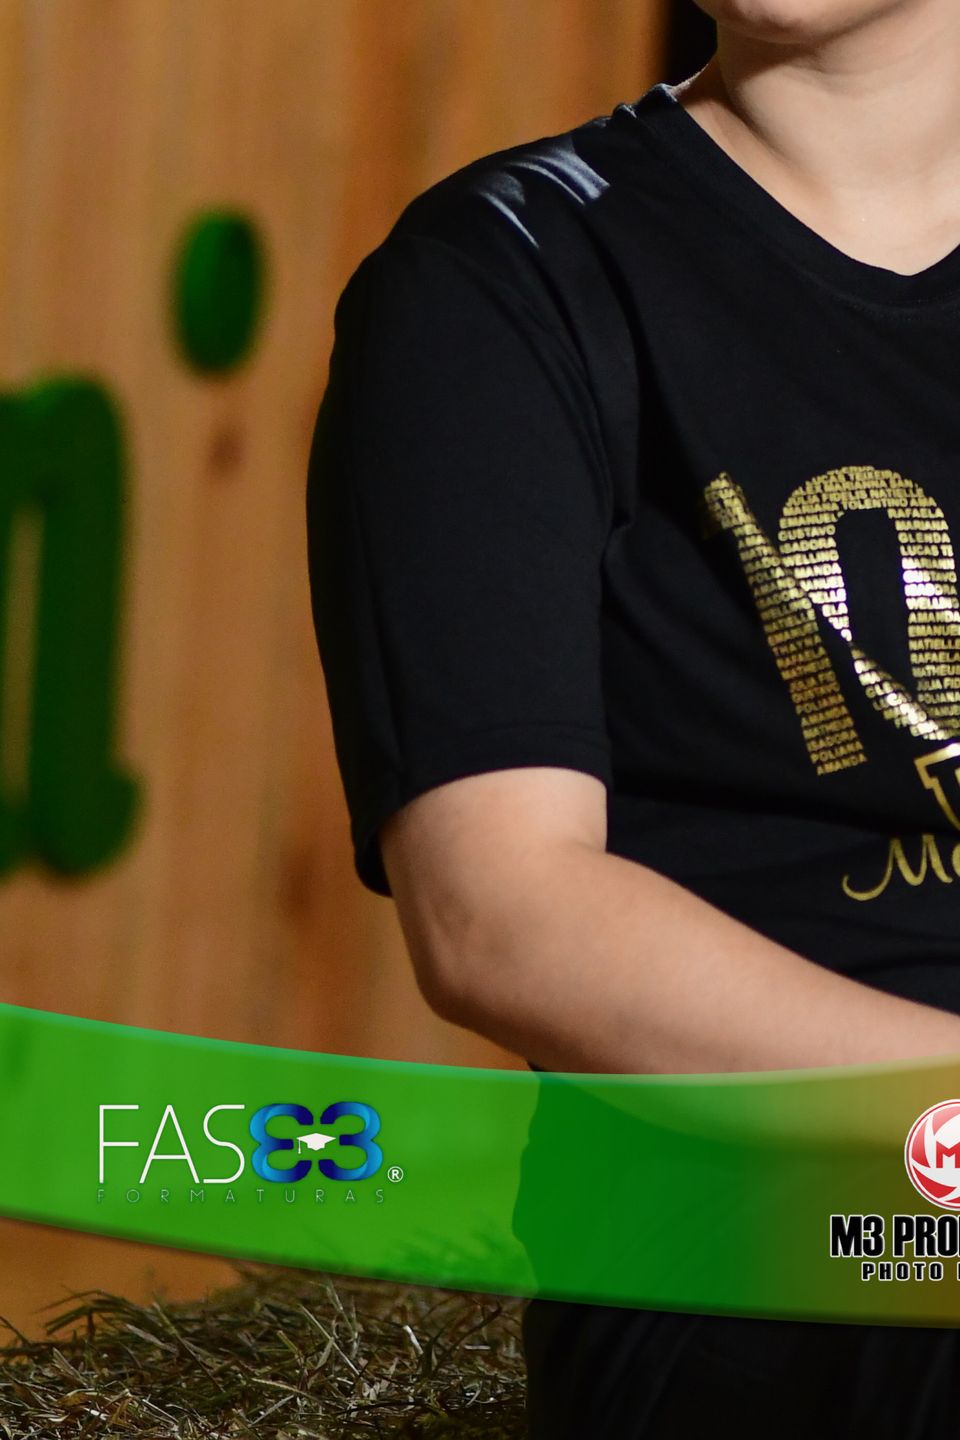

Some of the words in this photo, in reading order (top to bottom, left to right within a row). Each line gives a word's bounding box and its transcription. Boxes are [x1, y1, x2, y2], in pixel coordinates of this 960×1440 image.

[887, 508, 944, 519] RAFAELA
[778, 525, 835, 541] GUSTAVO
[898, 532, 950, 544] GLENDA
[900, 545, 939, 557] LUCAS
[794, 562, 842, 578] MANDA
[910, 651, 960, 664] RAFAELA
